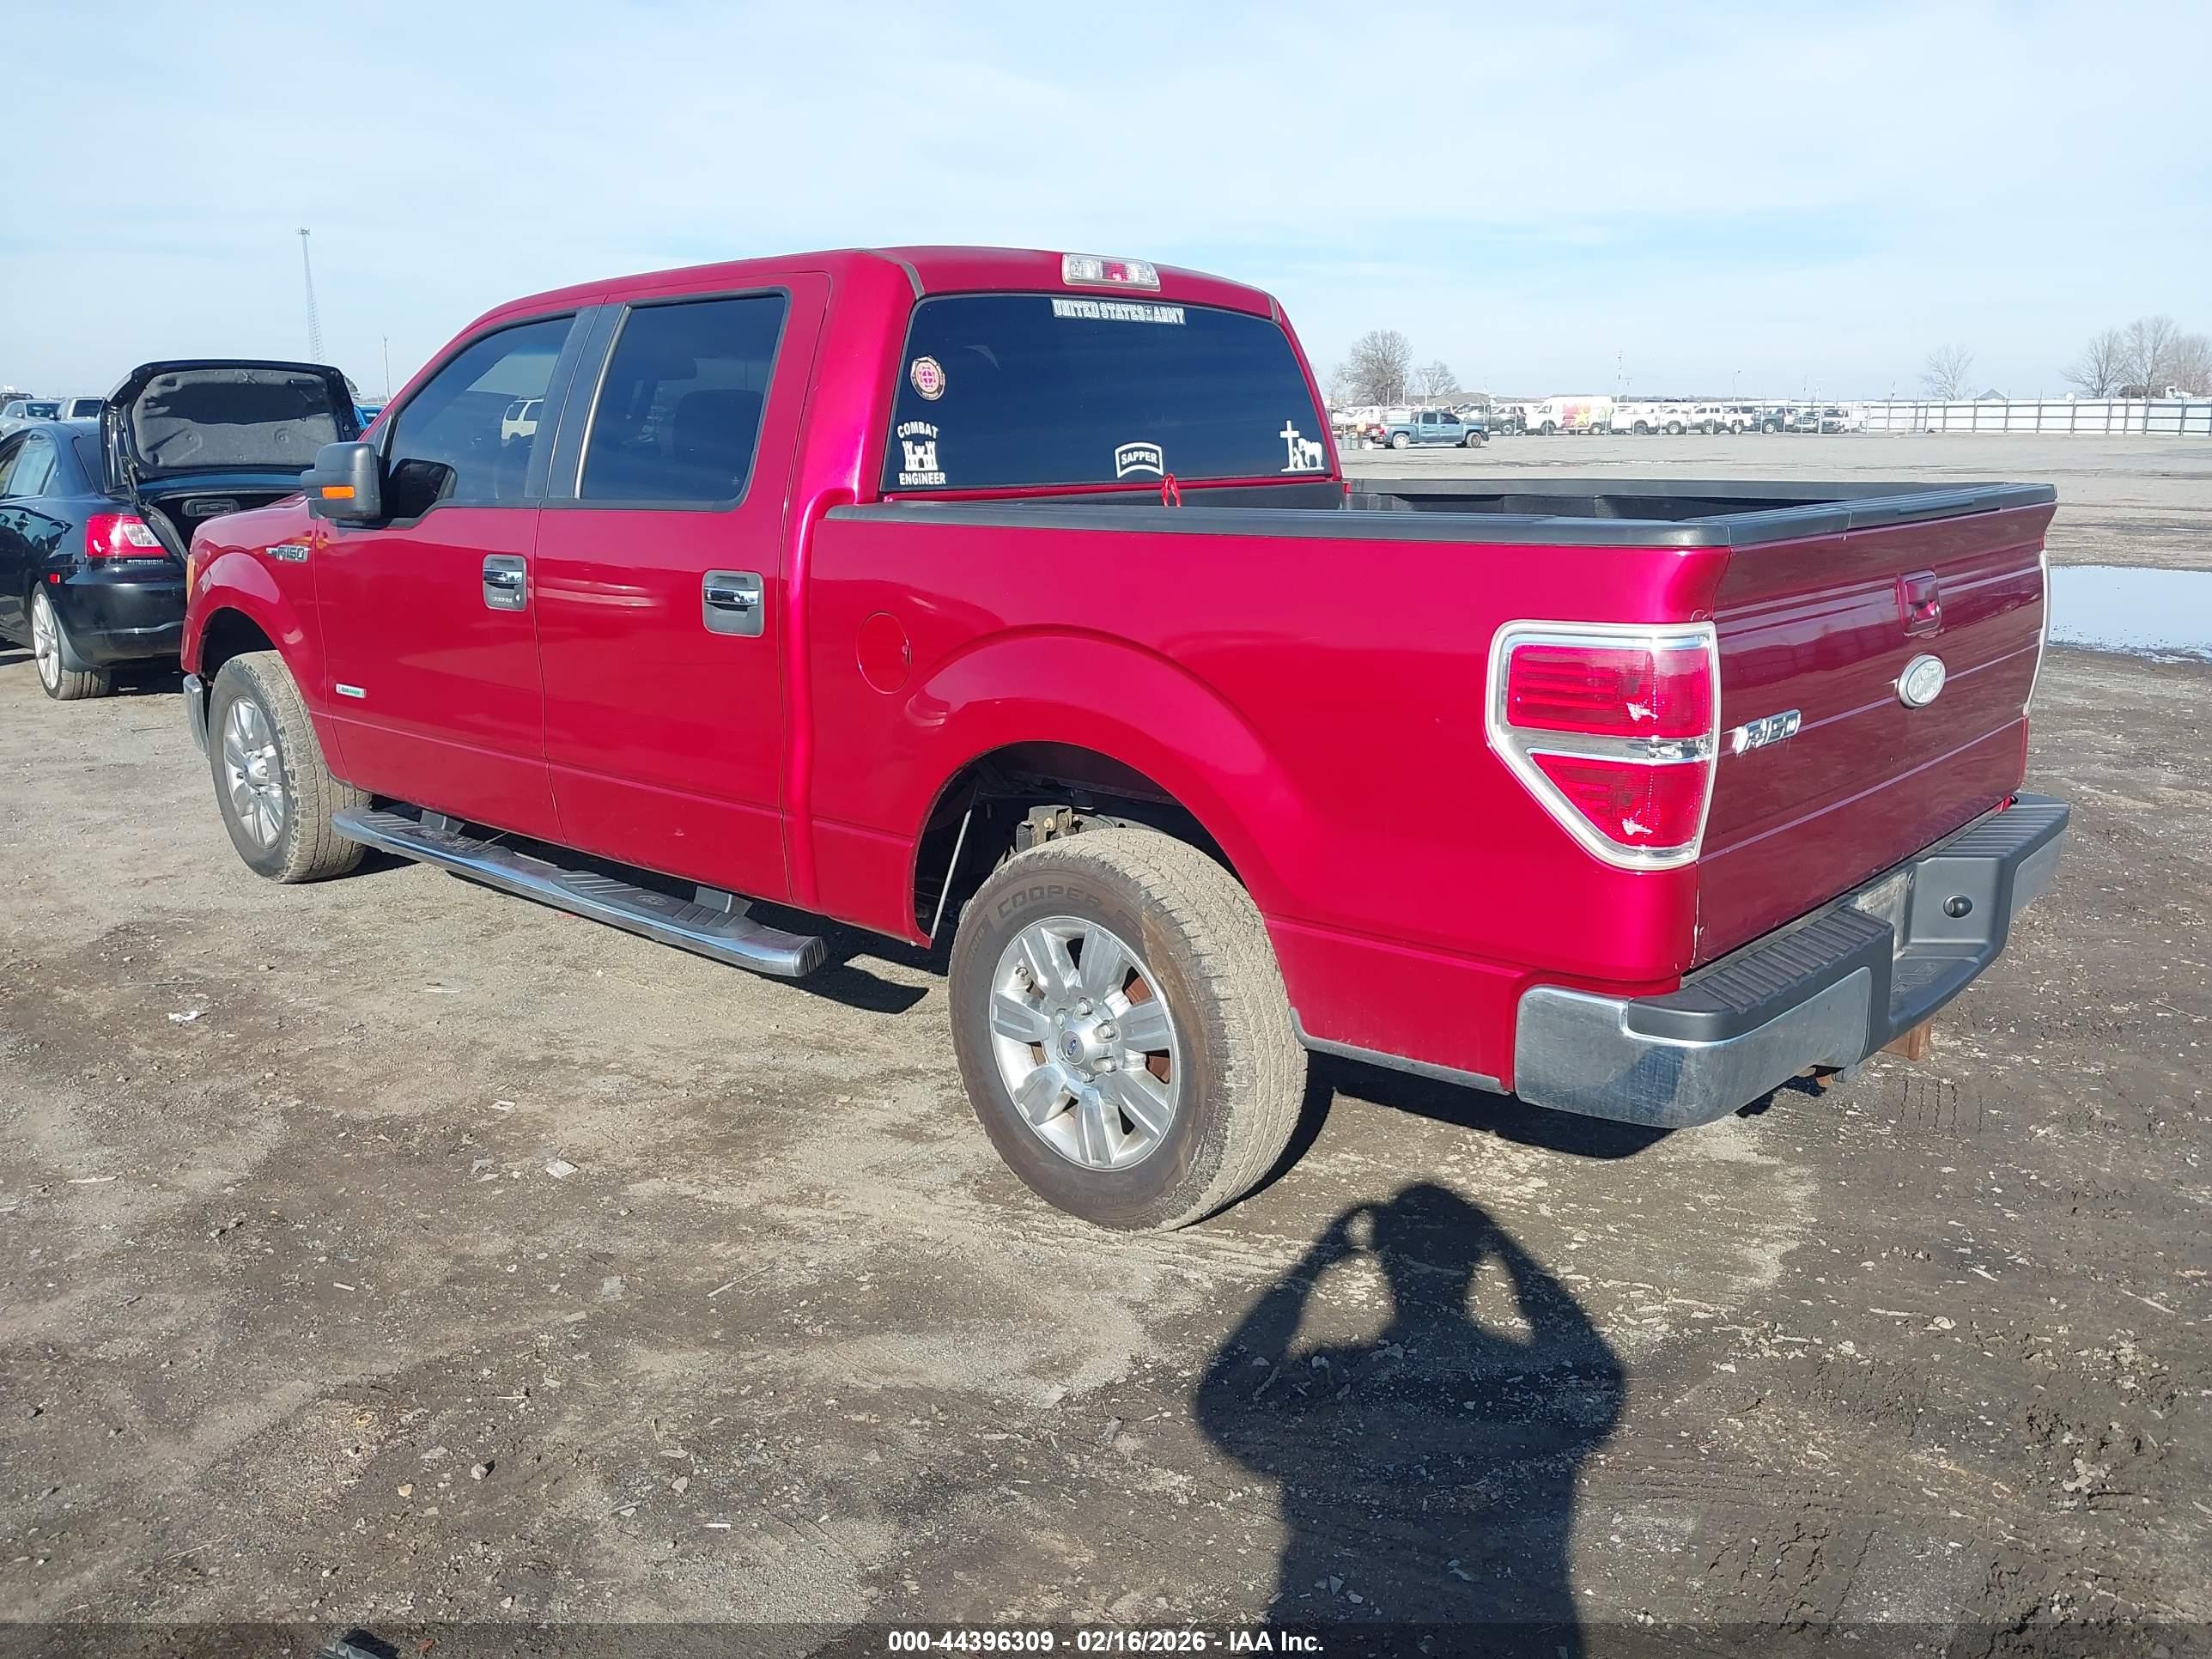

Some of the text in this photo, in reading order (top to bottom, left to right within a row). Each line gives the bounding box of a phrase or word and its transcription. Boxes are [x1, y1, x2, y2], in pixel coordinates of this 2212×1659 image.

[1052, 299, 1184, 324] UNITED STATES ARMY
[897, 421, 939, 439] COMBAT
[1121, 451, 1158, 465] SAPPER
[898, 472, 946, 486] ENGINEER
[997, 884, 1102, 919] COOPER
